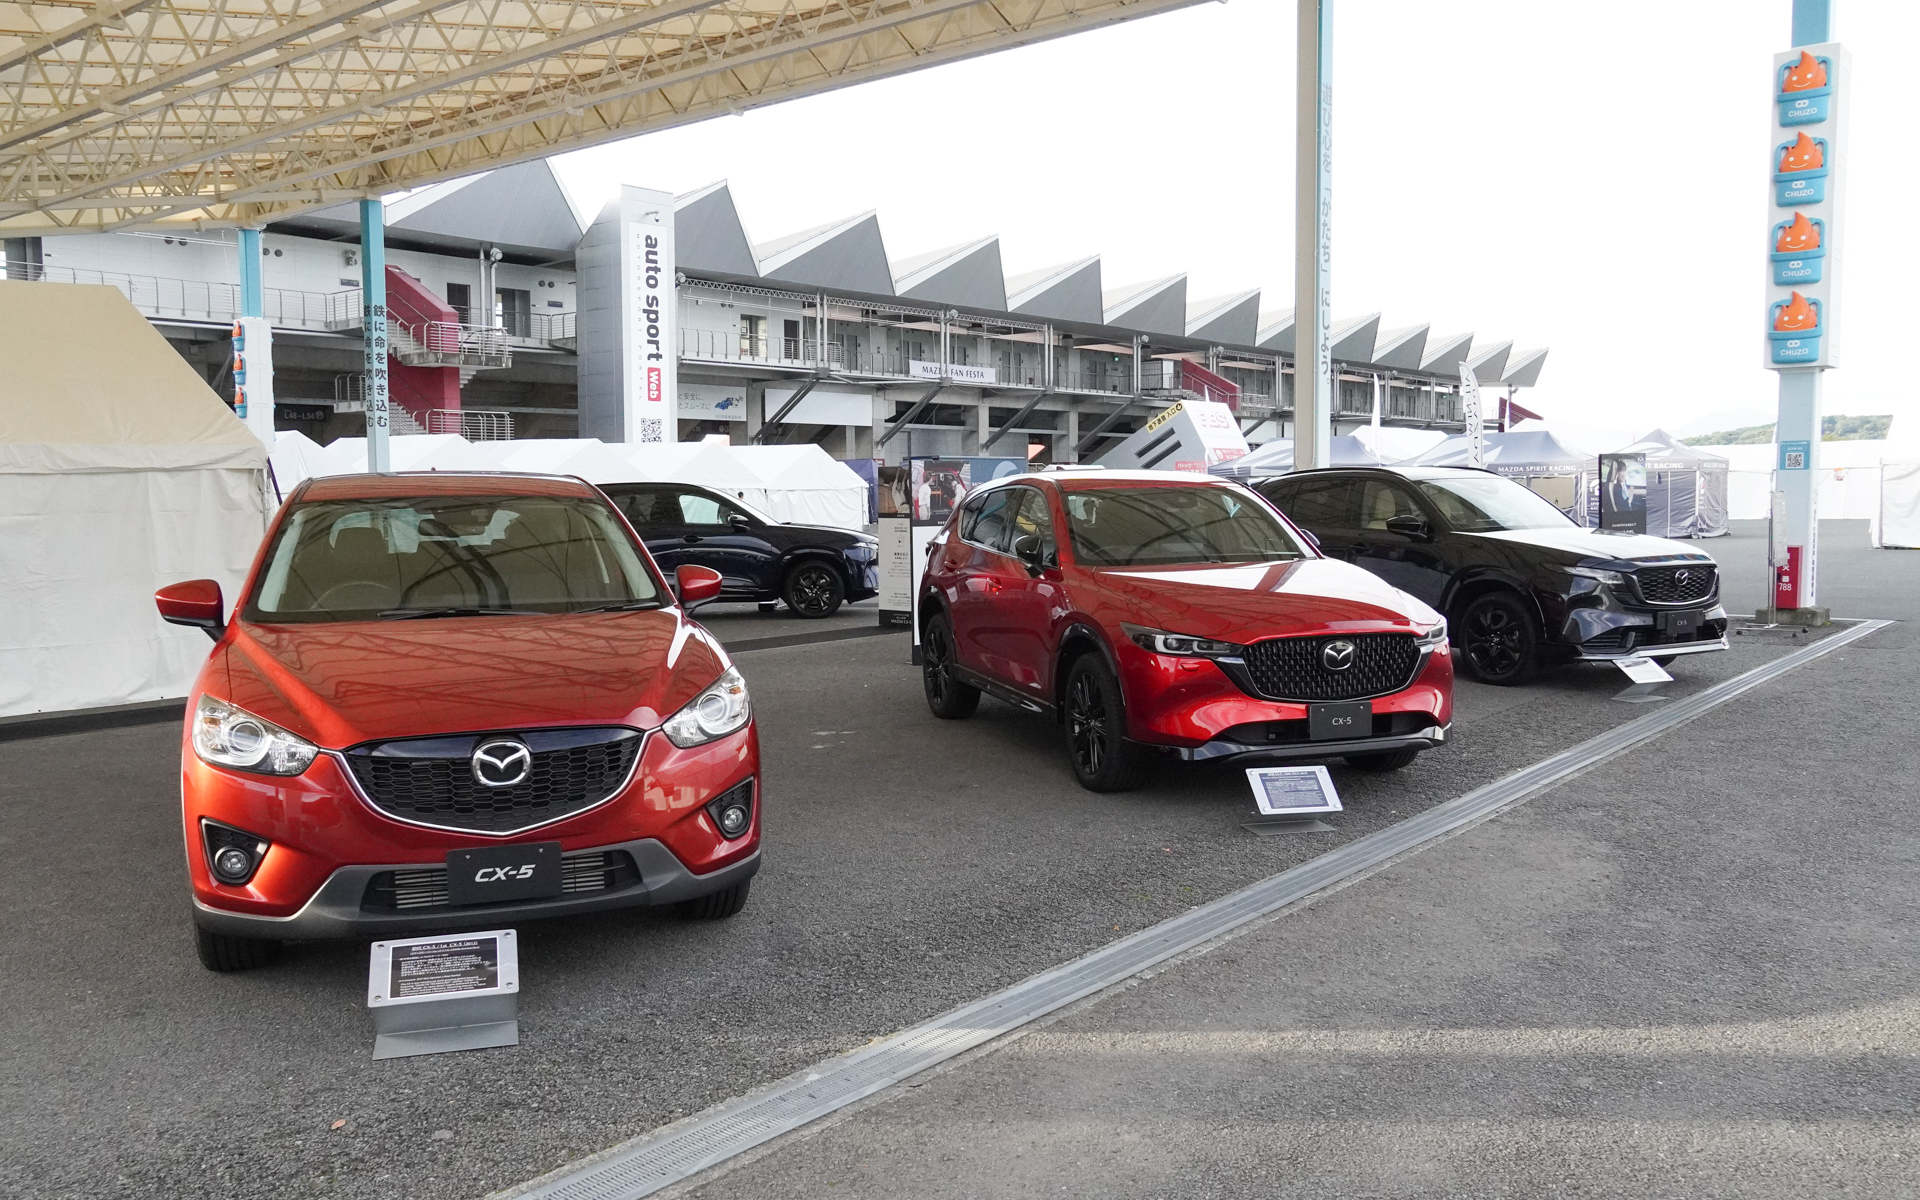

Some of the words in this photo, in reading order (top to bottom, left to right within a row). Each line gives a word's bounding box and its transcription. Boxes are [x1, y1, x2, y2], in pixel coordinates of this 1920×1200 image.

[1788, 107, 1818, 117] CHUZO
[1785, 188, 1814, 198] CHUZO
[644, 233, 662, 289] auto
[1782, 268, 1811, 278] CHUZO
[642, 294, 663, 362] sport
[1779, 347, 1809, 357] CHUZO
[373, 304, 388, 428] 鉄に命を吹き込む
[950, 368, 964, 377] FAN
[966, 370, 985, 379] FESTA
[649, 370, 659, 399] Web
[1166, 407, 1177, 418] 入口
[1779, 583, 1791, 591] 788
[1332, 716, 1352, 725] CX-5
[475, 864, 536, 883] CX-5
